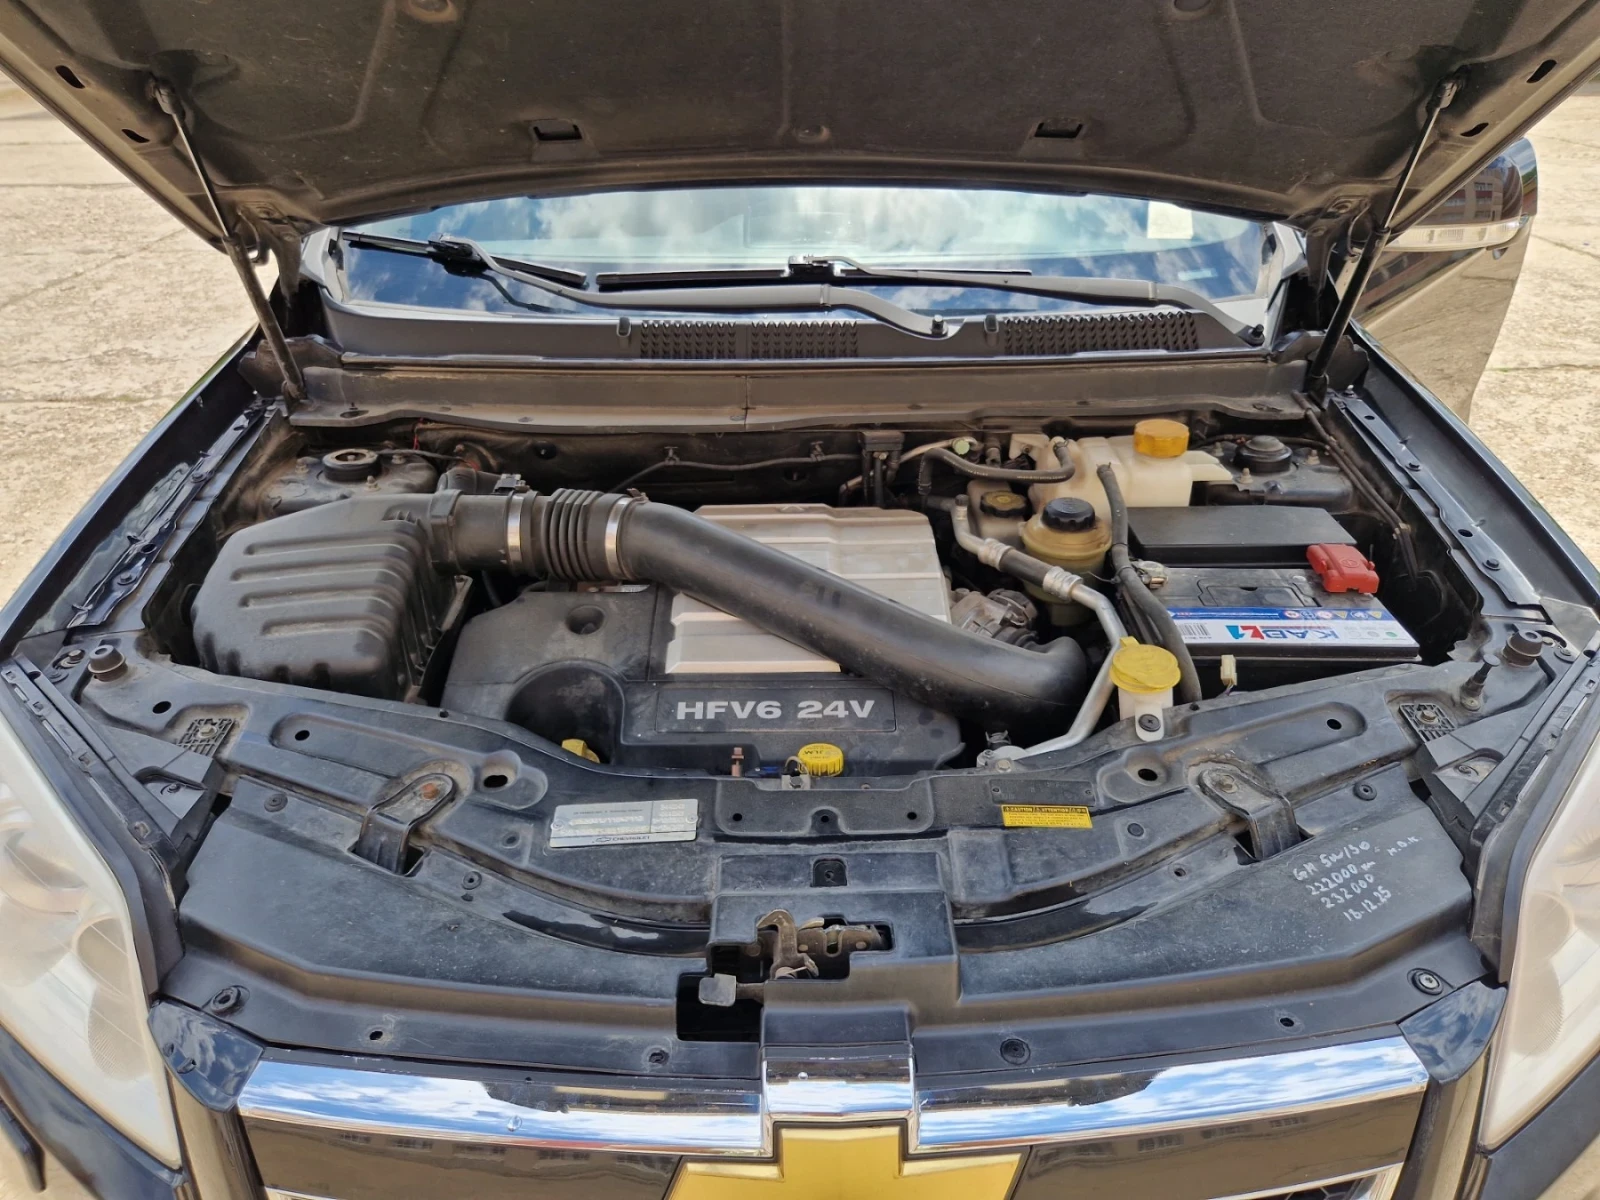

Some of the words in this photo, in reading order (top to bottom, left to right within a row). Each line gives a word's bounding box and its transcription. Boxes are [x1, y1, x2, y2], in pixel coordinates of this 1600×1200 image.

[677, 700, 782, 720] HFV6
[797, 700, 875, 719] 24V
[1306, 864, 1358, 895] 222000
